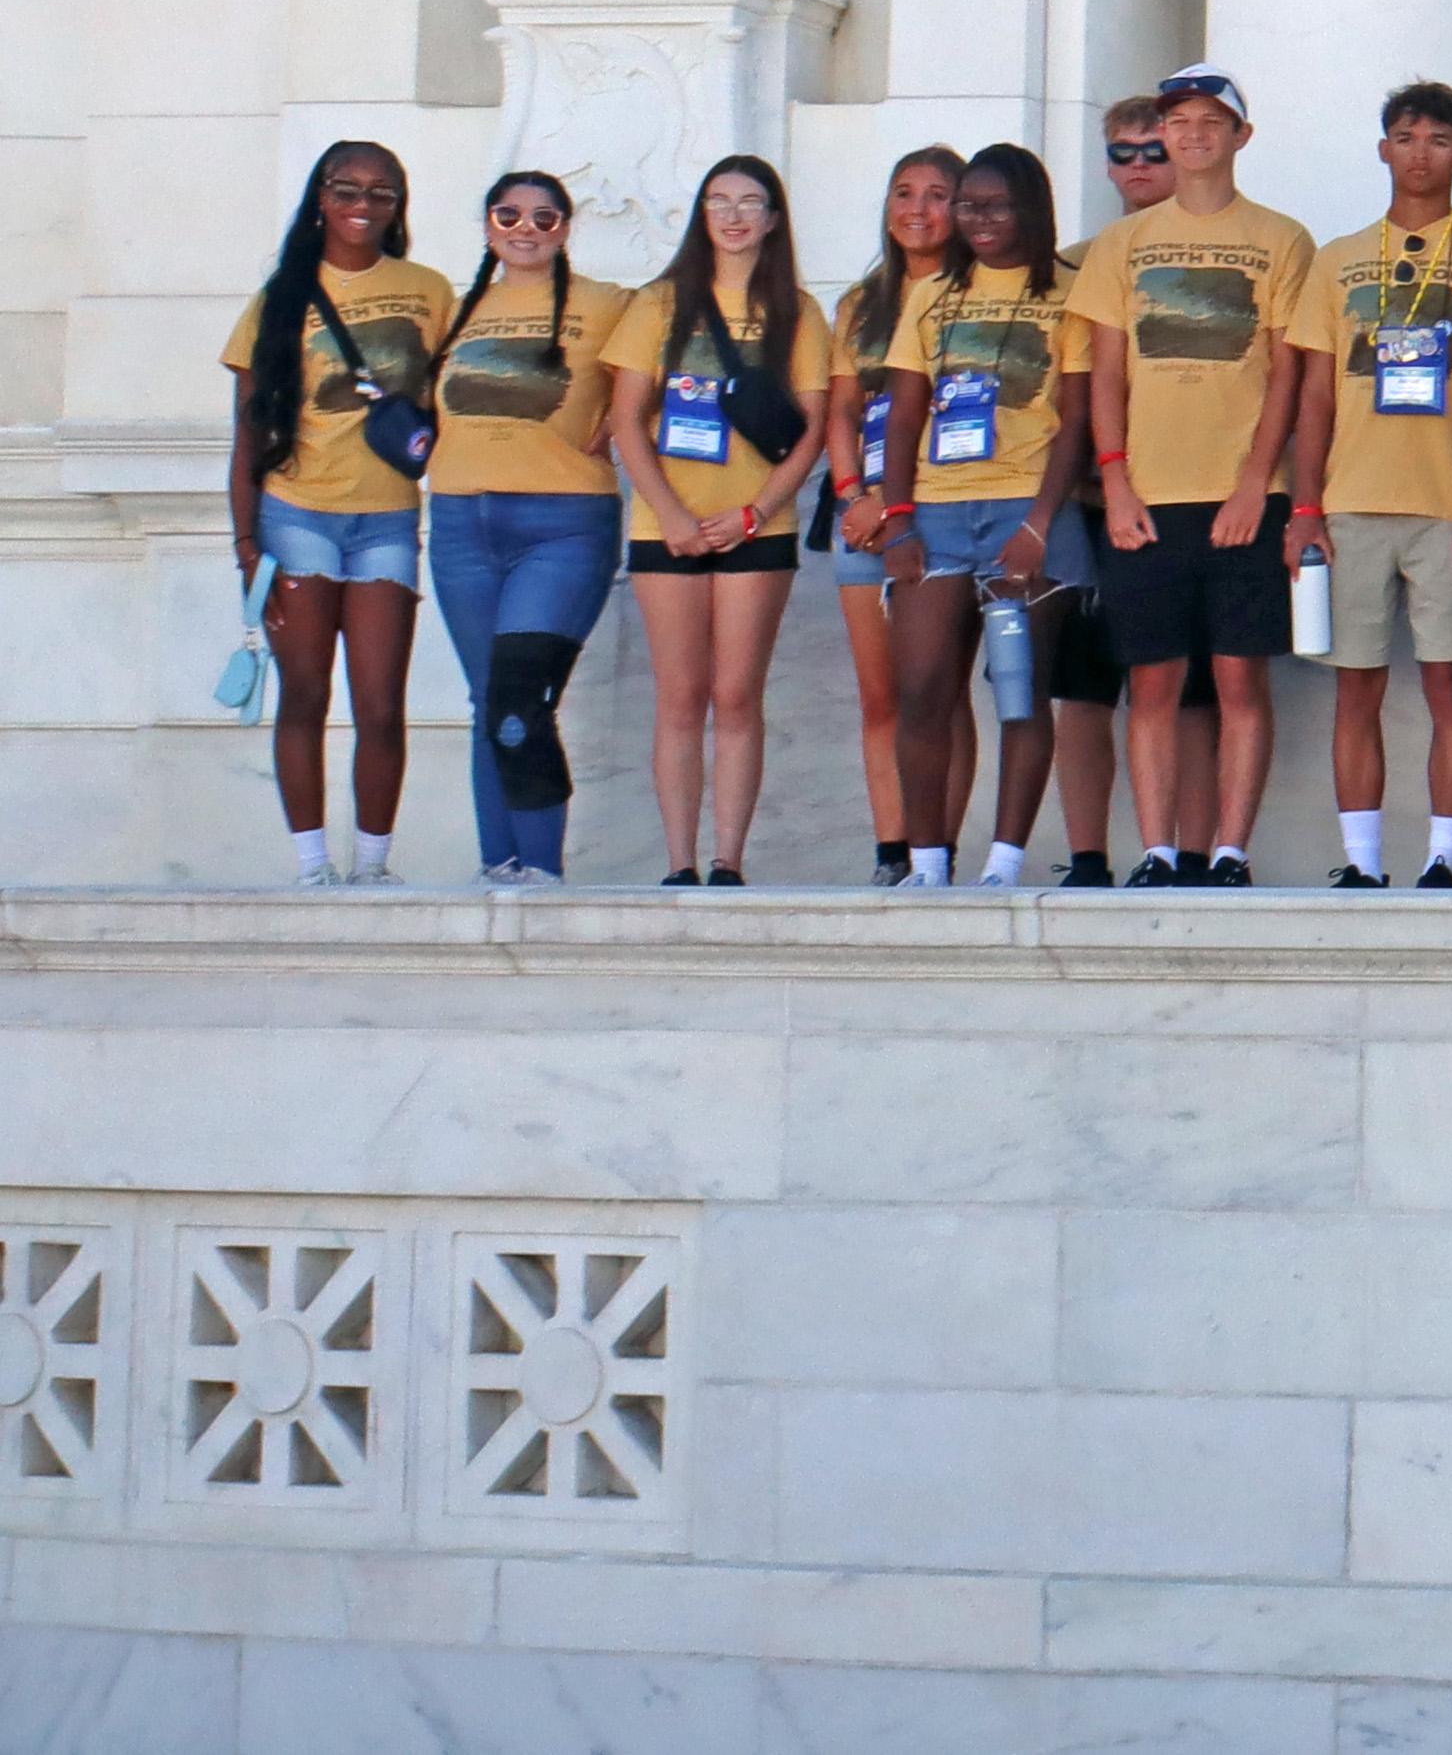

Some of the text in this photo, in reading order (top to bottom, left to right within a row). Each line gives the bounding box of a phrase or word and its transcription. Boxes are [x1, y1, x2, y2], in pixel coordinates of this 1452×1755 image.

[1128, 251, 1271, 272] YOUTH TOUR
[1338, 268, 1392, 287] YOUT
[930, 307, 1065, 322] YOUTH TOUR
[463, 325, 518, 341] OUTH
